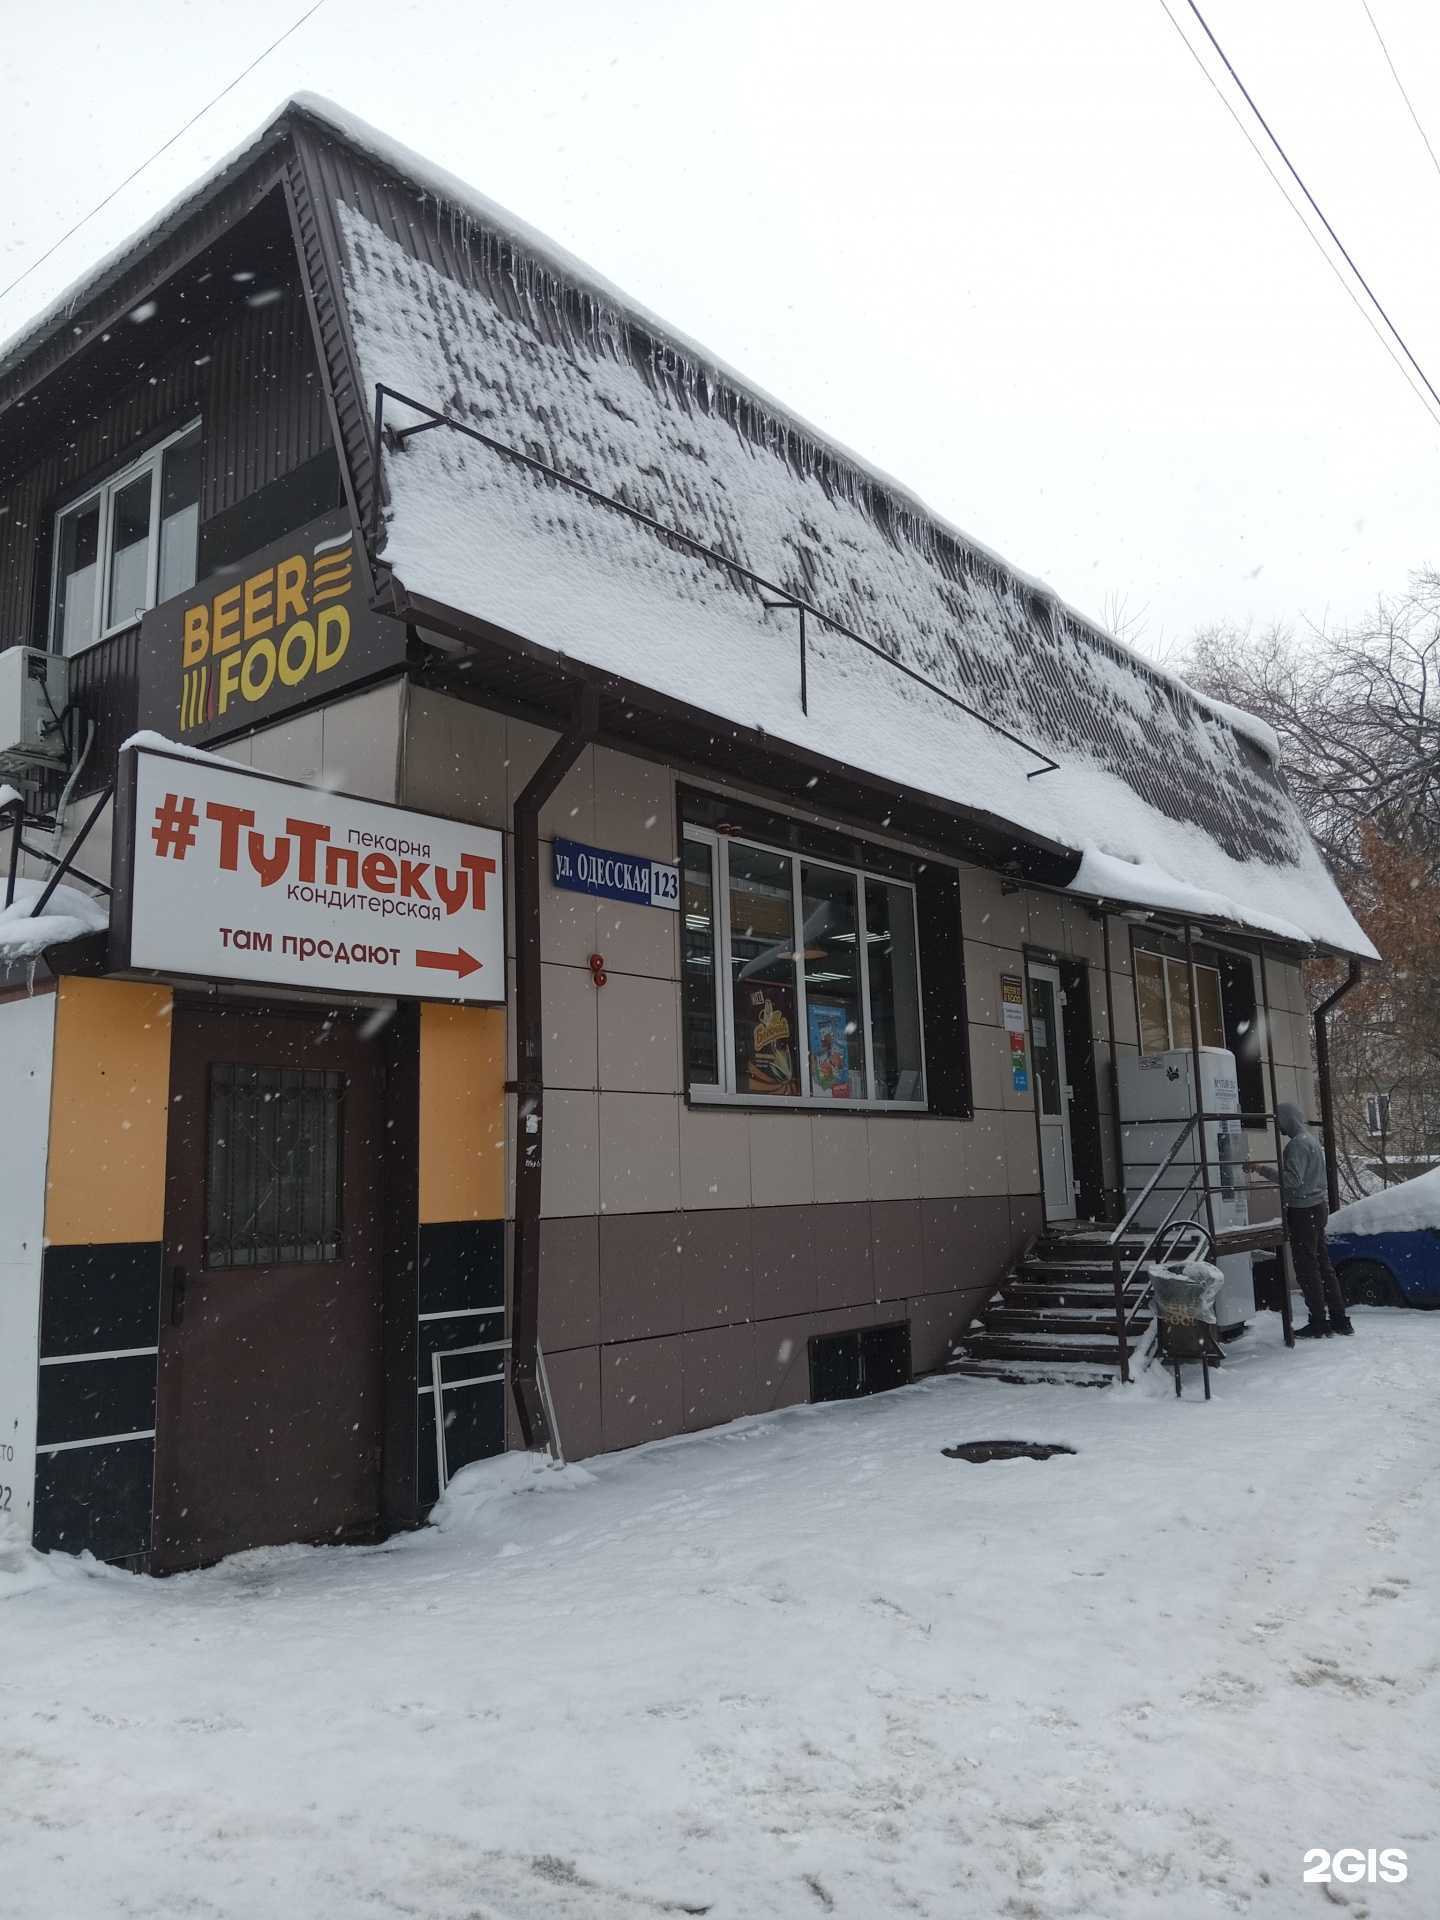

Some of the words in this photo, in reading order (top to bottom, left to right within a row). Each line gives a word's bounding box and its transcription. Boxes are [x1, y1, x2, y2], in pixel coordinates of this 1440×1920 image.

[183, 555, 308, 668] BEER
[218, 604, 350, 716] FOOD
[348, 829, 431, 858] пекарня
[556, 854, 573, 880] ул.
[577, 853, 650, 894] ОДЕССКАЯ
[654, 870, 678, 899] 123
[287, 884, 441, 921] кондитерская
[219, 927, 273, 952] там
[282, 935, 401, 966] продают
